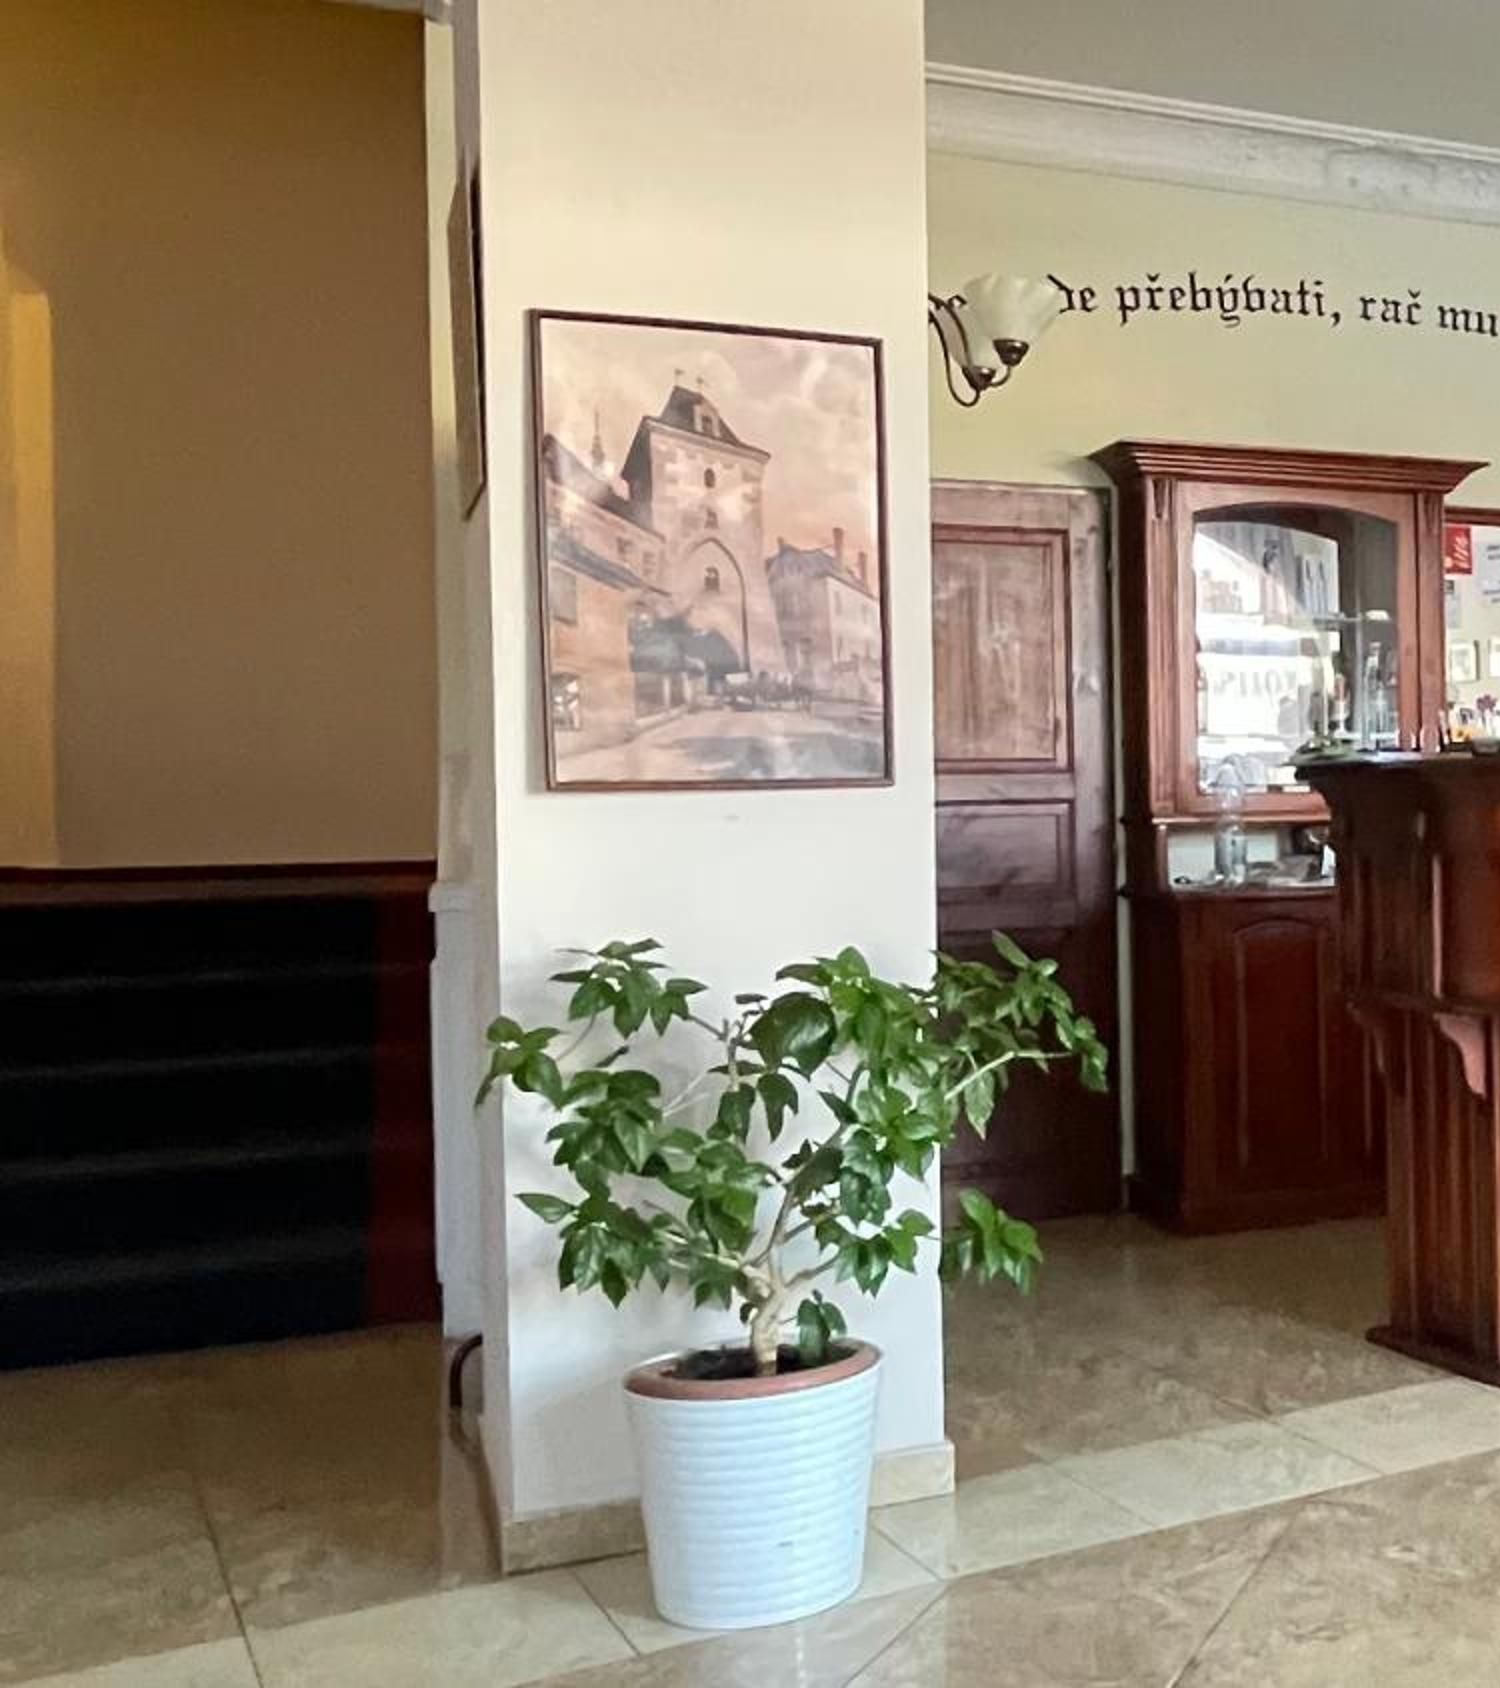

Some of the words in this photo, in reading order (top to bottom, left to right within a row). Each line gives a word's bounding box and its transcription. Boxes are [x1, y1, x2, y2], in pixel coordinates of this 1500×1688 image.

[1115, 271, 1341, 328] přebývati,
[1359, 289, 1422, 326] rač
[1437, 305, 1499, 338] mu
